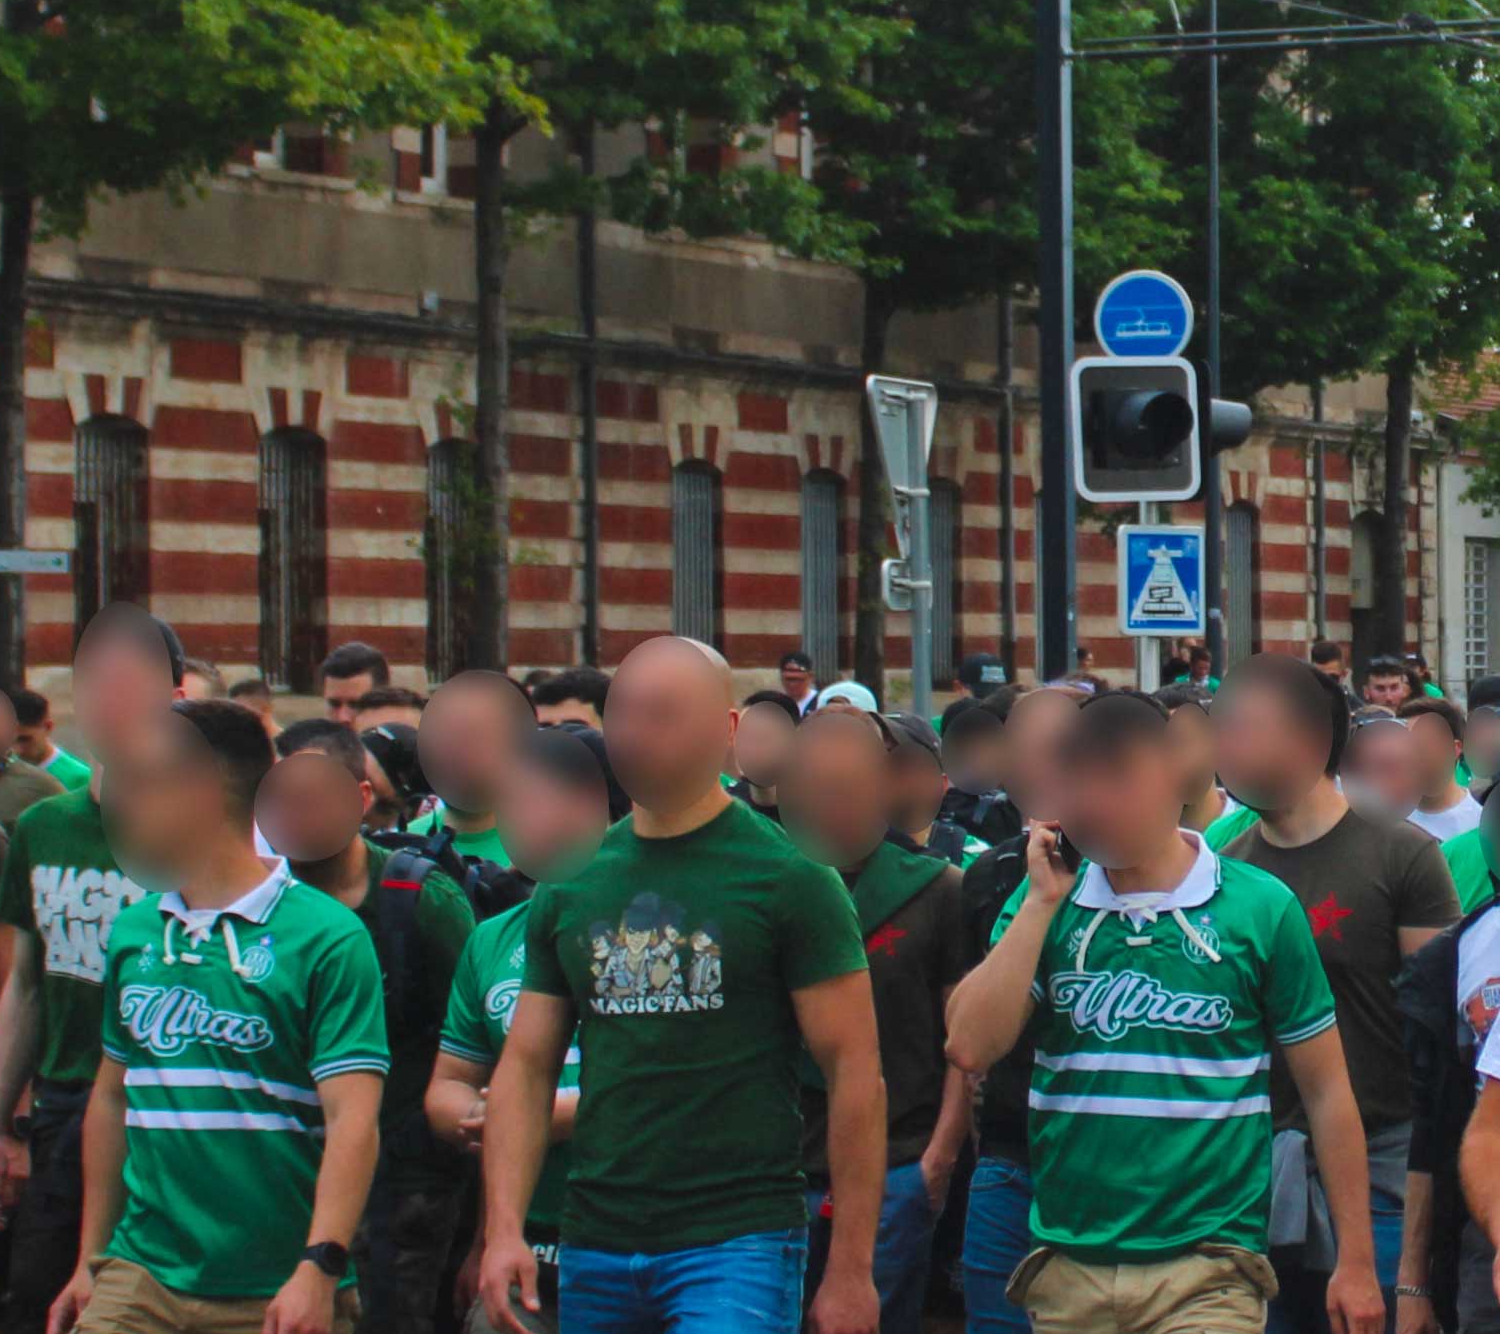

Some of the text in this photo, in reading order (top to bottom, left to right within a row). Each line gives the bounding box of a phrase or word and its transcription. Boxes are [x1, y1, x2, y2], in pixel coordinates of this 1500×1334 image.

[119, 984, 273, 1057] Ultras
[663, 992, 724, 1012] FANS
[1049, 970, 1234, 1042] Ultras
